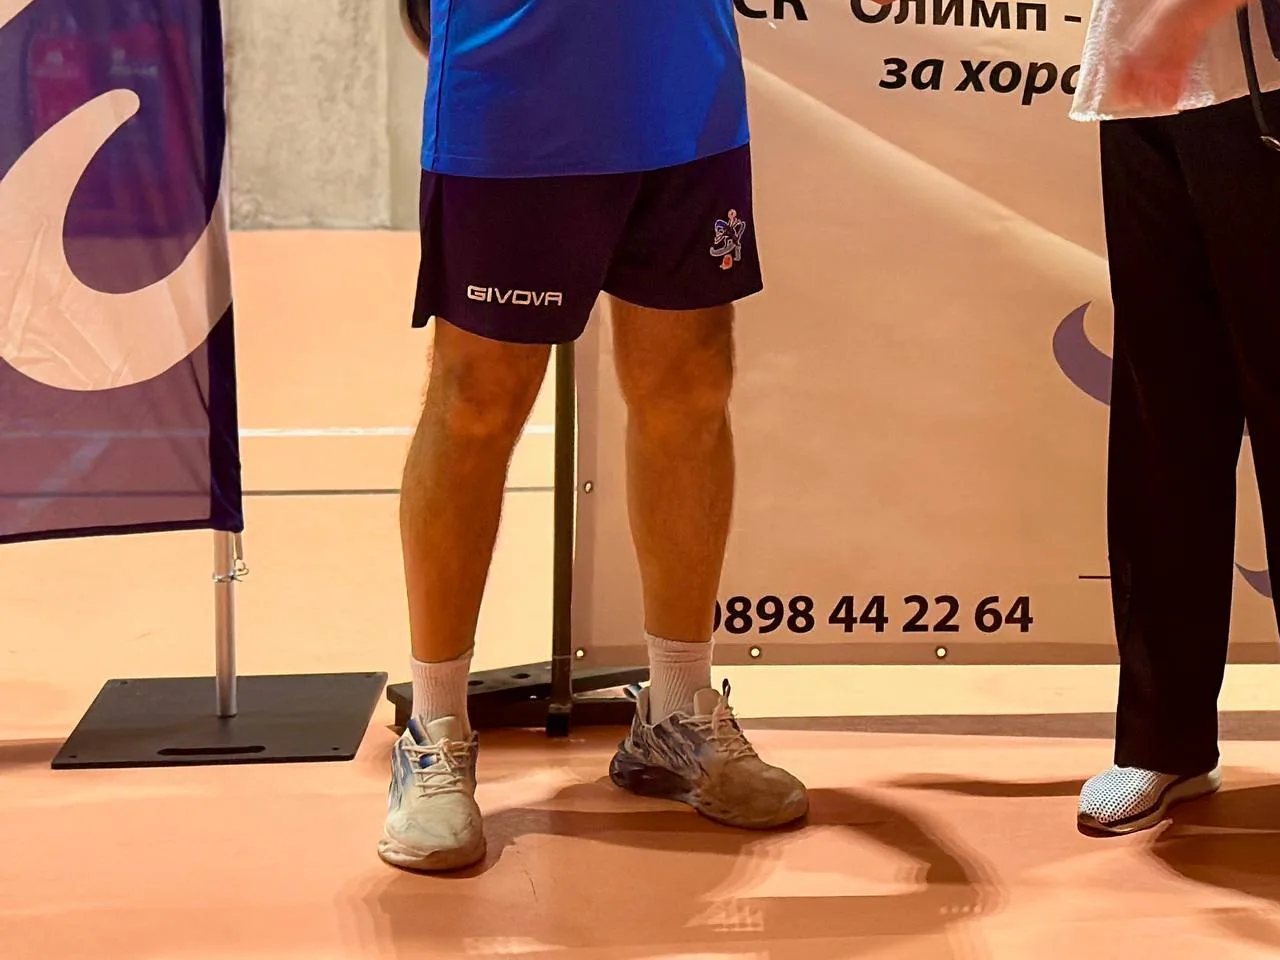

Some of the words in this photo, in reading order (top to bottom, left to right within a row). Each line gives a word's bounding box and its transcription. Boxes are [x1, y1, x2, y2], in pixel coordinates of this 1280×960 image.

[878, 57, 945, 91] за
[467, 284, 563, 306] GIVOVA
[713, 595, 815, 635] 898
[828, 595, 889, 633] 44
[902, 594, 960, 633] 22
[974, 595, 1034, 633] 64
